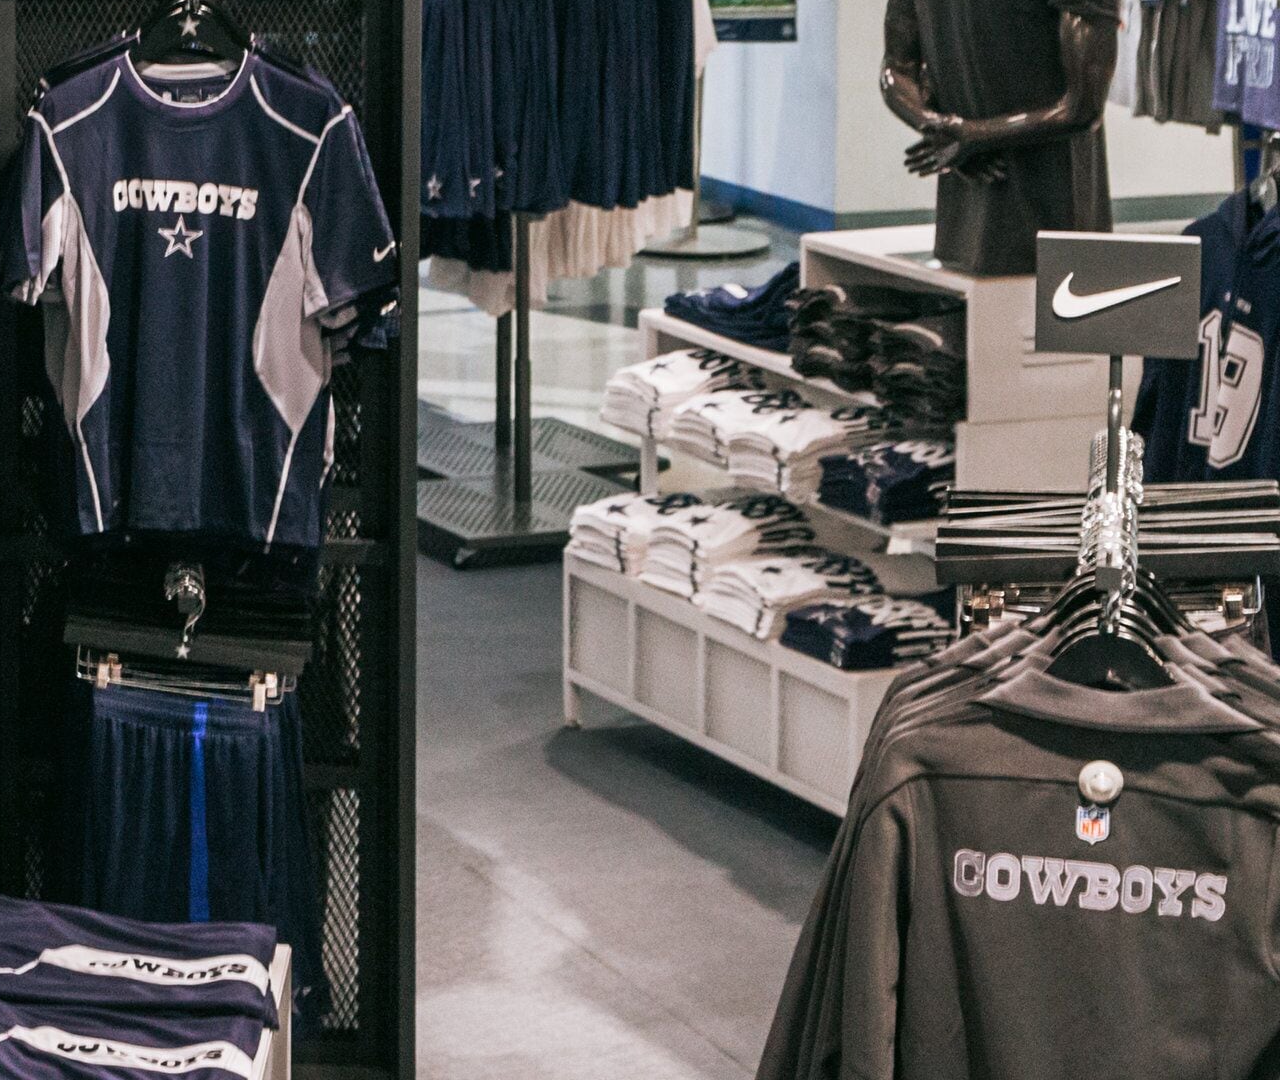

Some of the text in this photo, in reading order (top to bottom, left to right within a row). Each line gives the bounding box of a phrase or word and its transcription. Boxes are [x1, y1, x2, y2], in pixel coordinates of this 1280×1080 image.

[112, 178, 259, 221] COWBOYS
[1081, 818, 1105, 838] NFL
[953, 847, 1228, 922] COWBOYS
